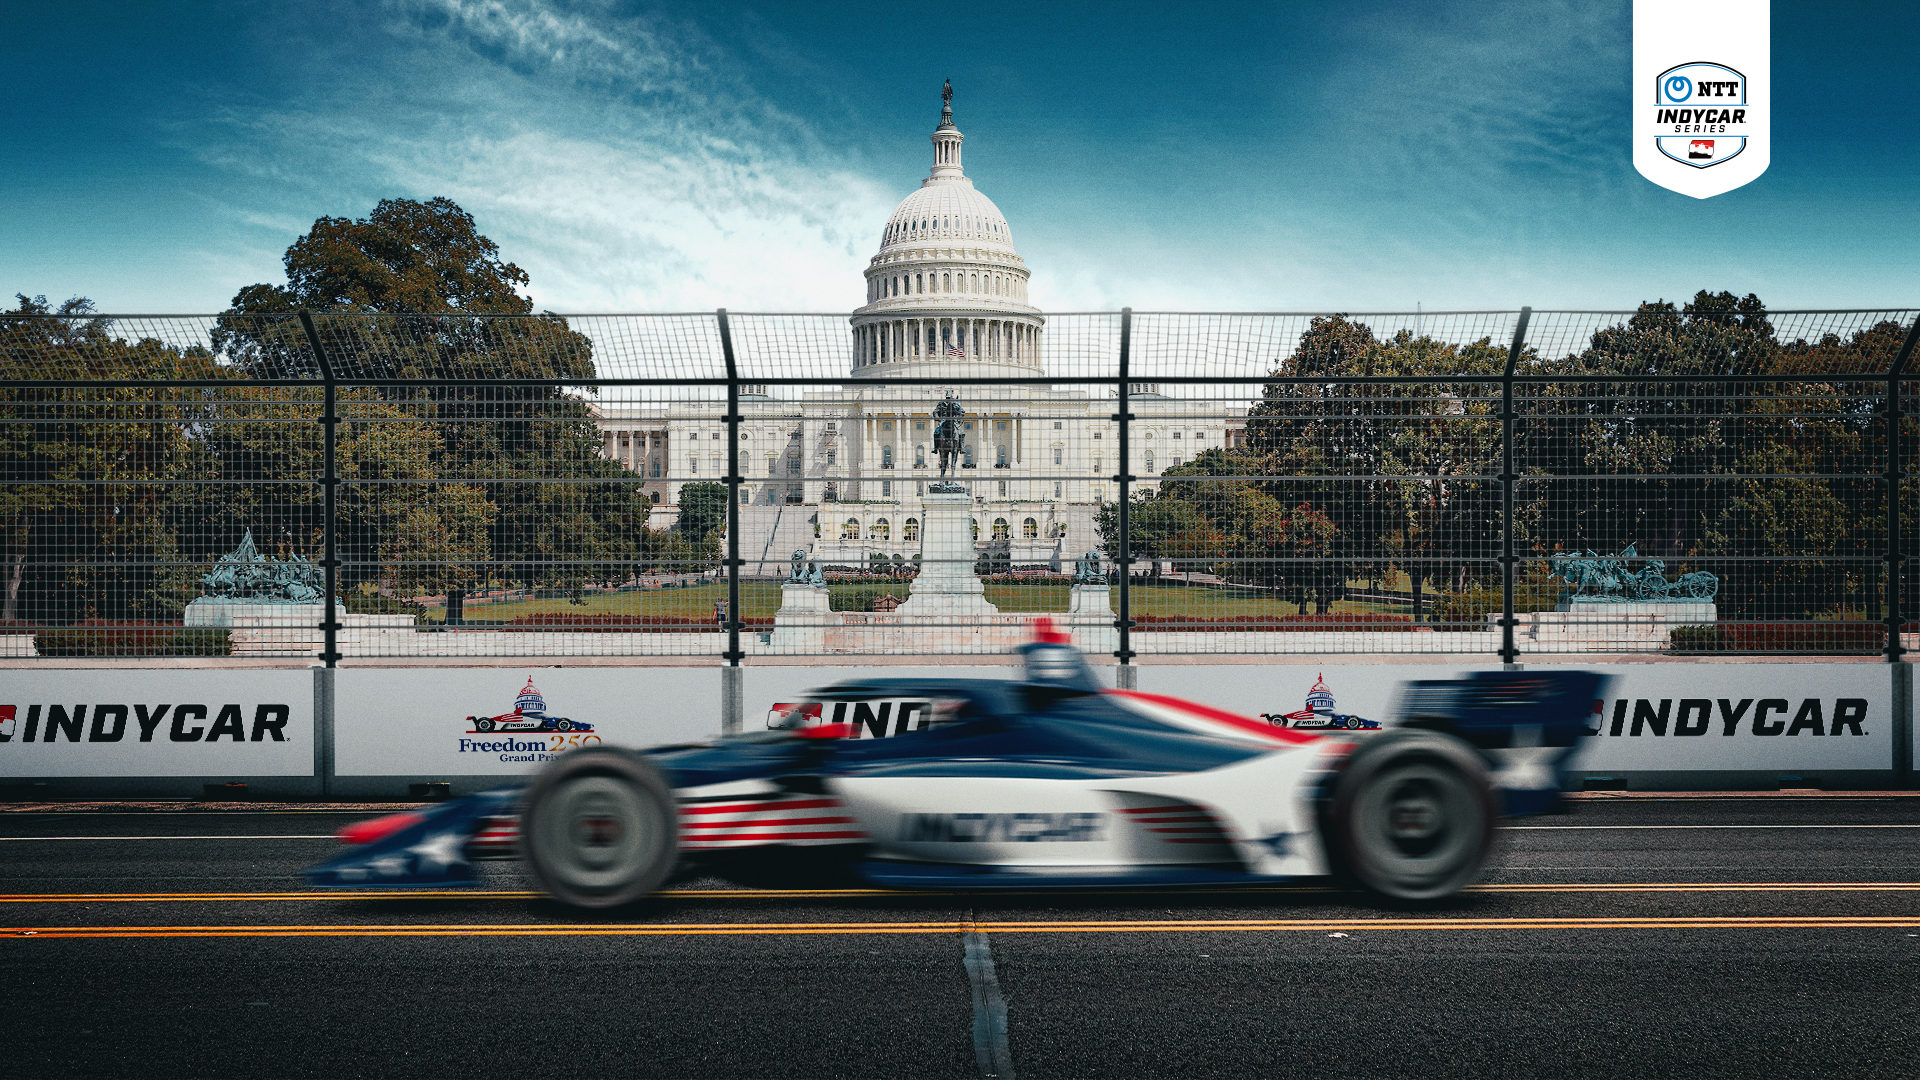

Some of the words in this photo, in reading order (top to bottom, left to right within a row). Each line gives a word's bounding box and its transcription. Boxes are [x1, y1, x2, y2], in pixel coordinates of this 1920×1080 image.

[22, 704, 290, 742] INDYCAR
[1609, 699, 1869, 736] INDYCAR
[459, 738, 547, 752] Freedom
[500, 754, 535, 762] Grand
